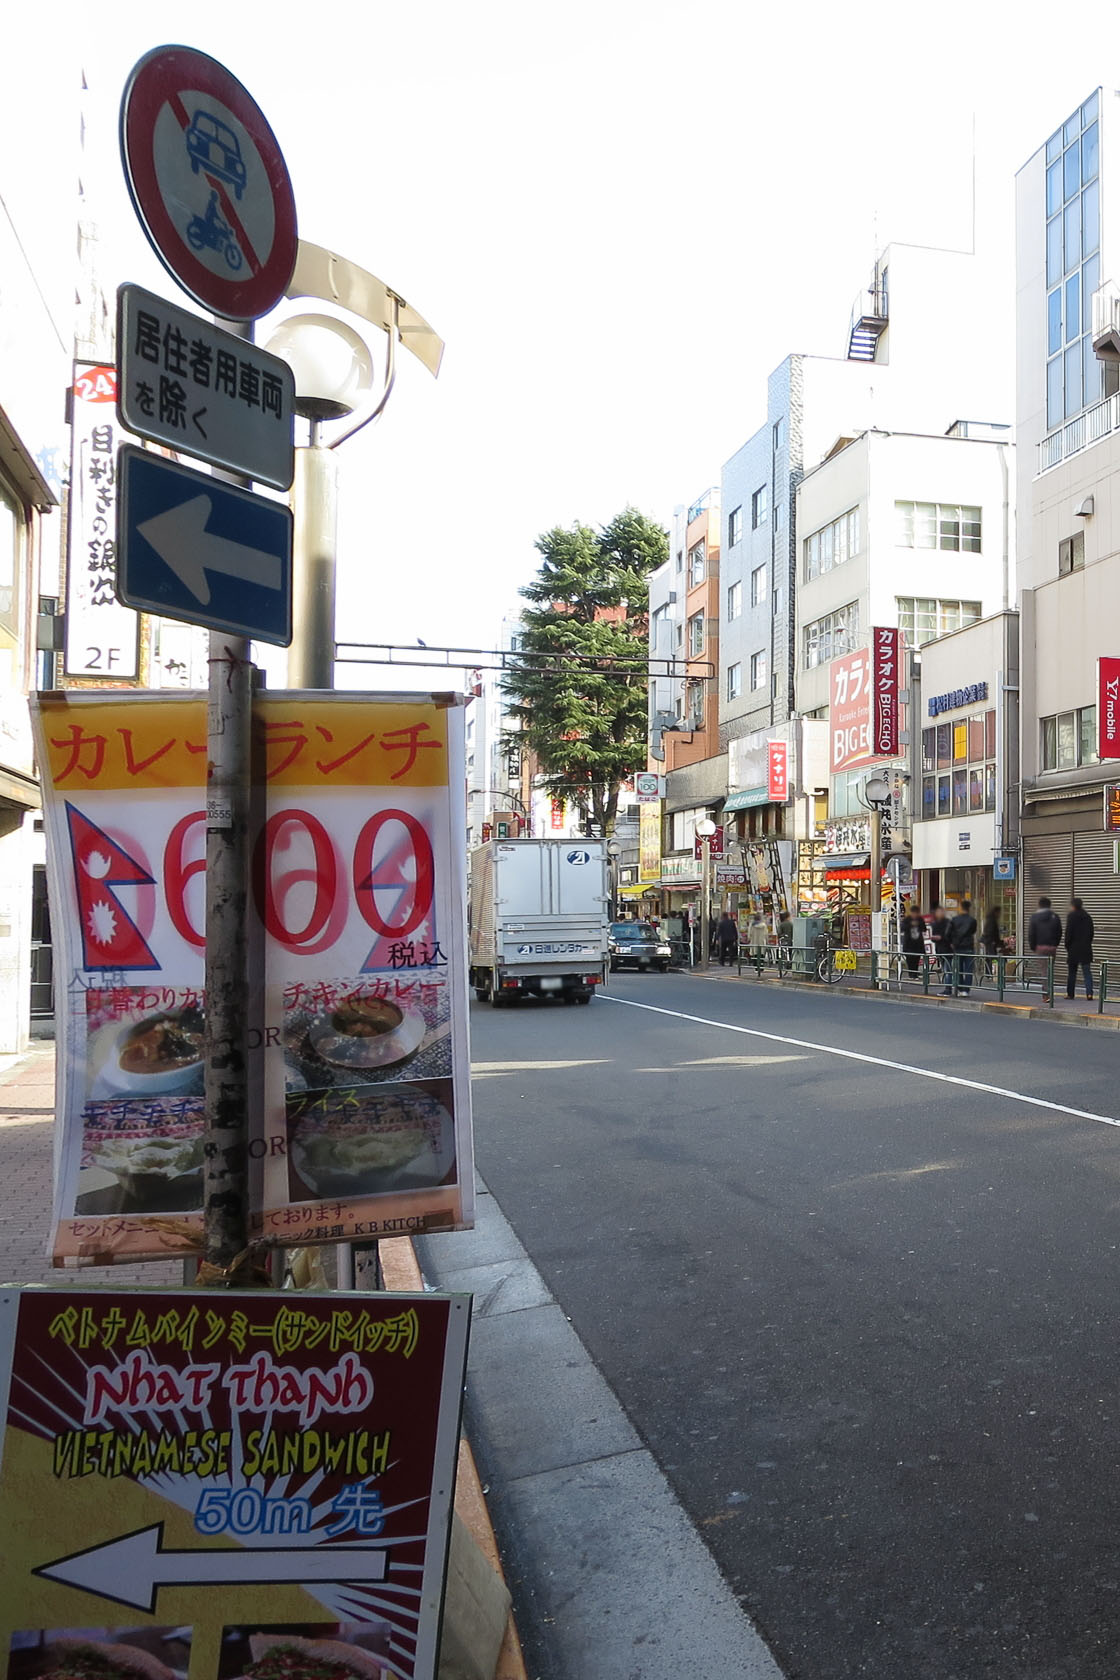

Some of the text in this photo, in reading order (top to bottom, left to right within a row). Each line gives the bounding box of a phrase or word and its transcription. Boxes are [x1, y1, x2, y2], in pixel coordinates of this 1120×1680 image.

[136, 310, 283, 420] 居住者用車両
[77, 372, 117, 400] 24
[135, 375, 207, 440] を除く
[84, 647, 121, 670] 2F
[879, 630, 894, 691] カラオケ
[880, 694, 891, 750] BIG ECHO
[1105, 674, 1119, 742] Y!mobile
[834, 726, 857, 766] BIG
[773, 752, 785, 785] ケナリ
[387, 942, 447, 968] 税込
[283, 978, 447, 1011] チキンカレー
[247, 1028, 281, 1050] OR
[248, 1137, 286, 1159] OR
[53, 1427, 392, 1479] VIETNAMESE SANDWICH
[195, 1482, 384, 1535] 50m 先
